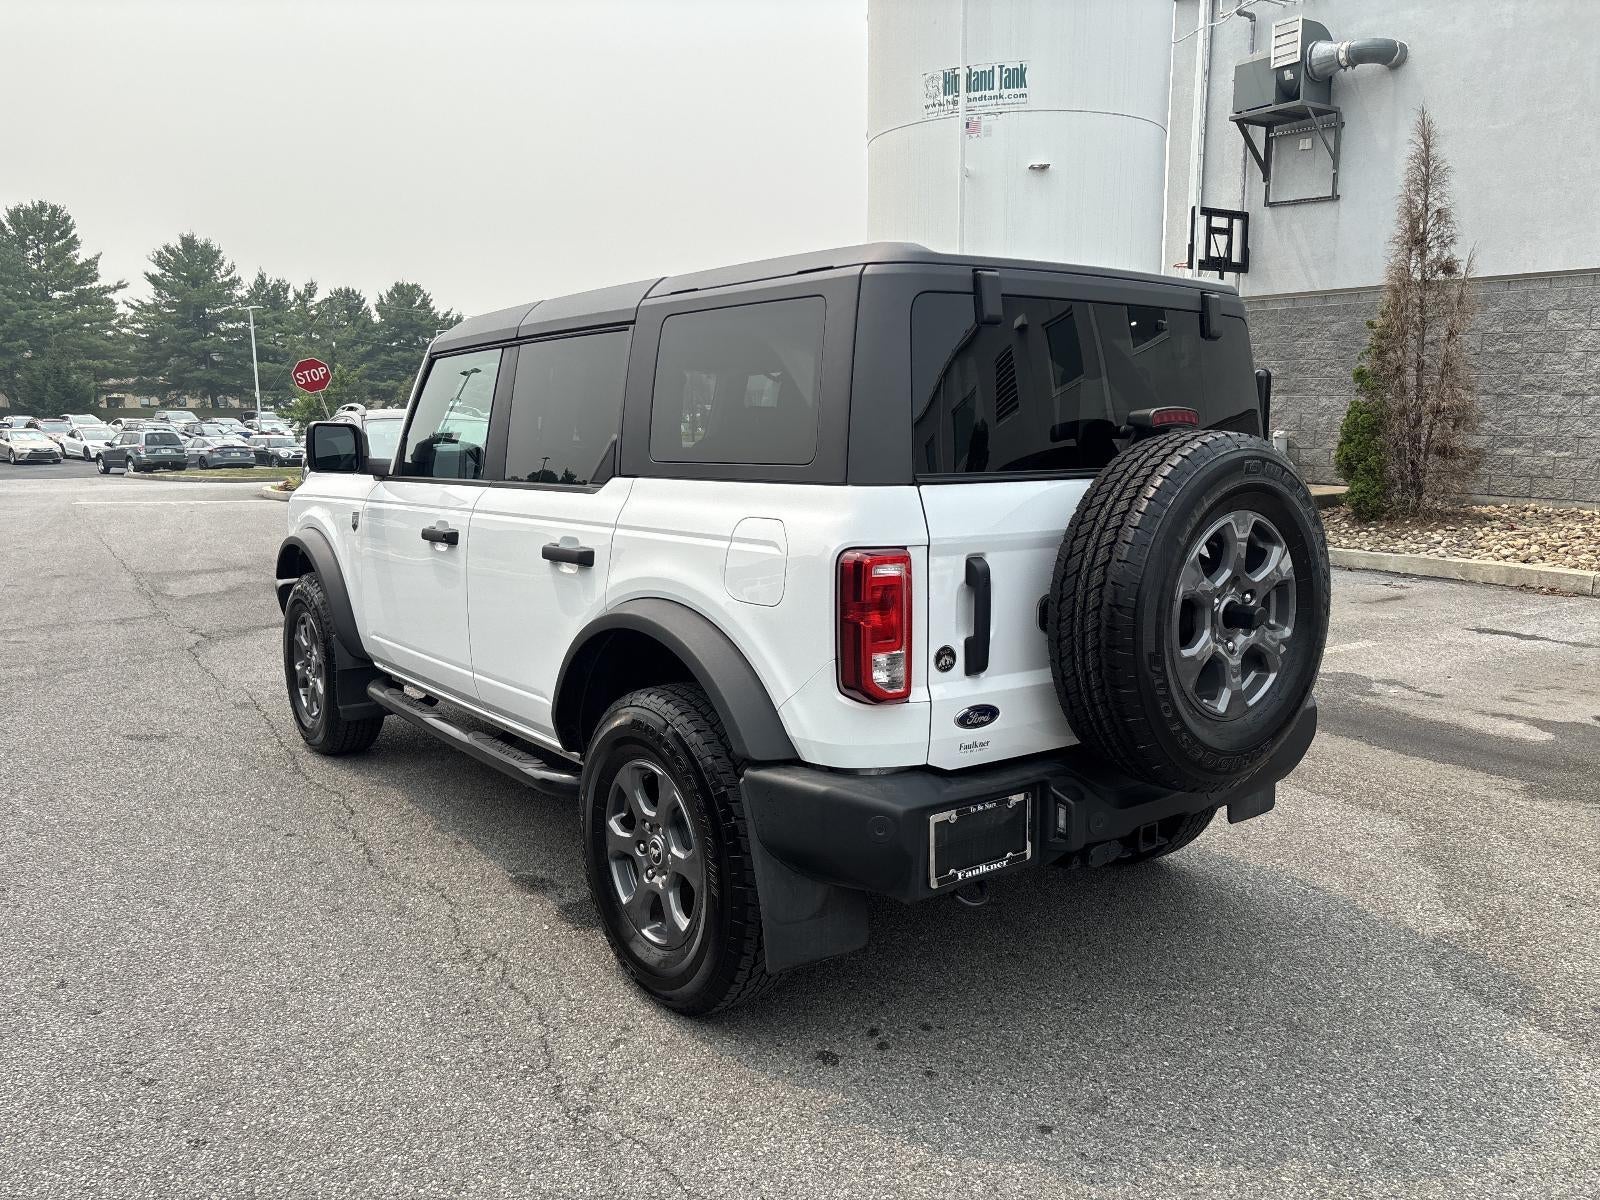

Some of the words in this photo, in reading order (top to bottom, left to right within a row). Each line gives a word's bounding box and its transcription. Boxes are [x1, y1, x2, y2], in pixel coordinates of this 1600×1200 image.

[998, 63, 1027, 90] Tank
[924, 92, 1027, 109] www.higlandtank.com
[296, 366, 327, 385] STOP
[966, 711, 990, 724] Ford
[959, 740, 990, 751] Faulkner
[957, 860, 1008, 880] Faulkner
